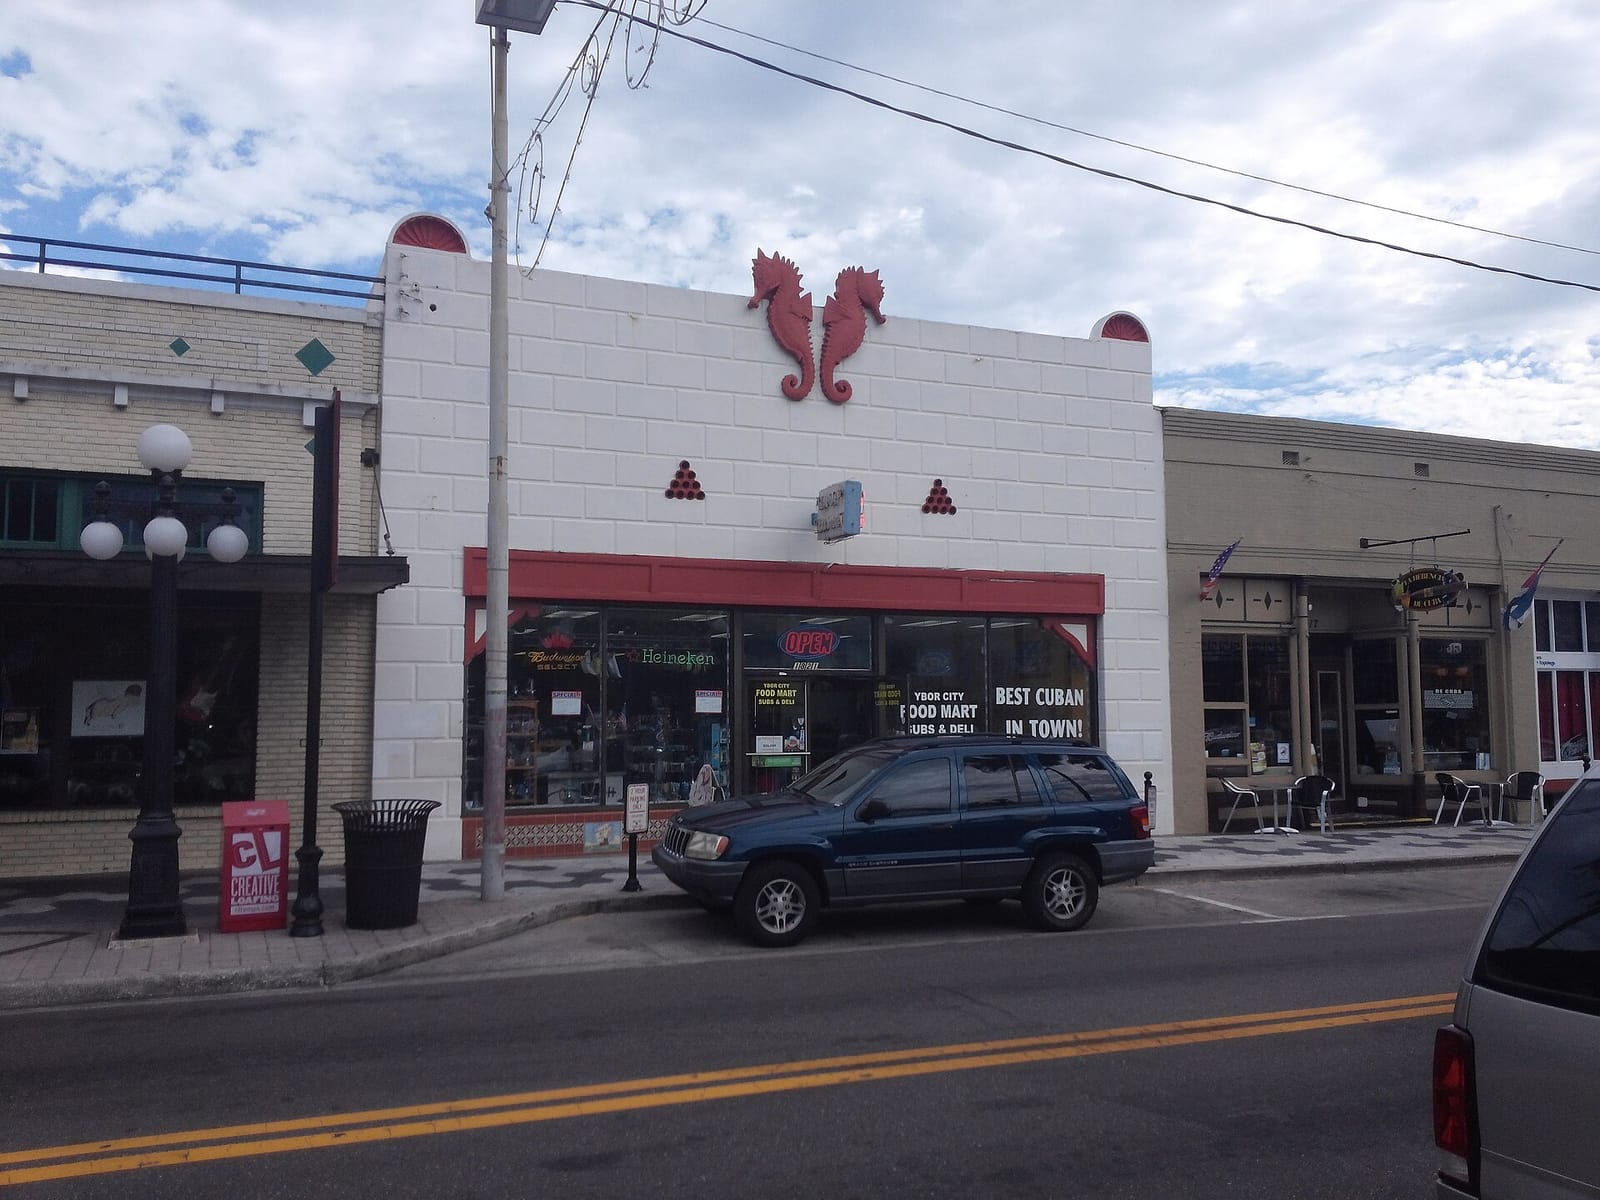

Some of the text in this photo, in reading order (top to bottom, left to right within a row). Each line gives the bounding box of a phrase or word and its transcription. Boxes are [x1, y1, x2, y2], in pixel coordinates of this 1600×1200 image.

[784, 631, 833, 654] OPEN
[641, 648, 716, 666] Heineken
[755, 689, 797, 697] FOOD MART
[914, 692, 964, 702] YBOR CITY
[996, 687, 1084, 707] BEST CUBAN
[941, 704, 978, 719] MART
[938, 724, 947, 735] &
[950, 724, 974, 735] DELI
[1005, 719, 1083, 739] IN TOWN!
[231, 875, 280, 896] CREATIVE
[231, 895, 279, 905] LOAFING
